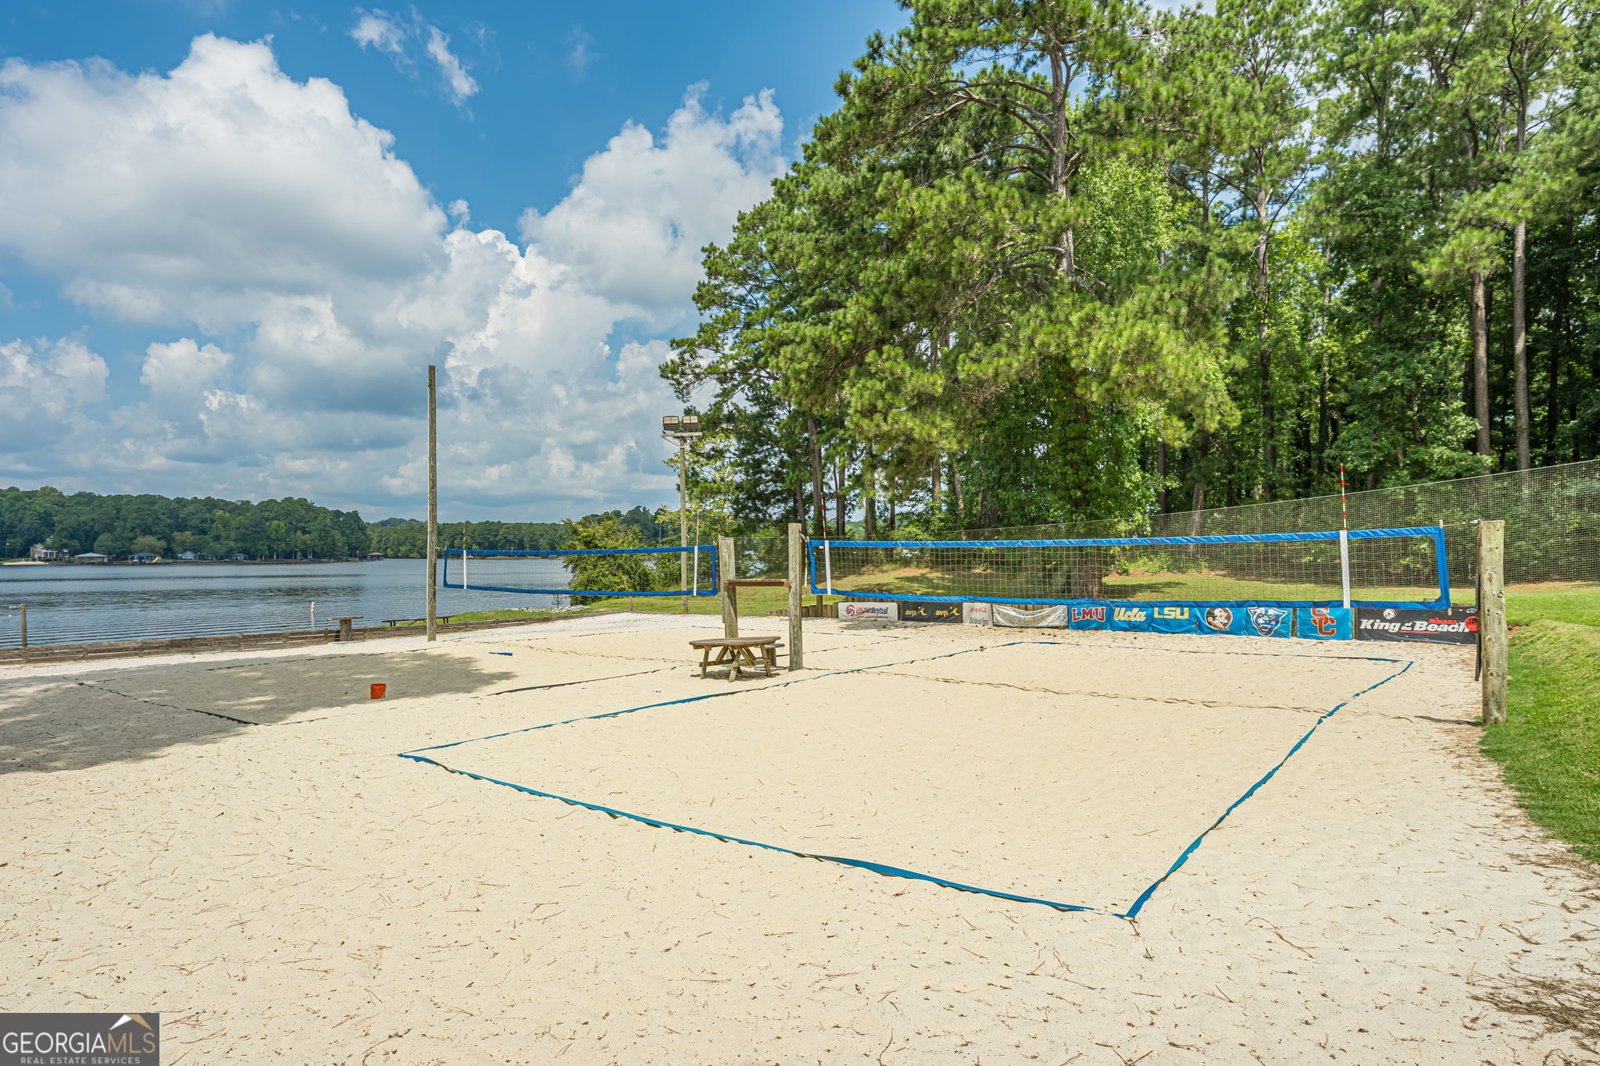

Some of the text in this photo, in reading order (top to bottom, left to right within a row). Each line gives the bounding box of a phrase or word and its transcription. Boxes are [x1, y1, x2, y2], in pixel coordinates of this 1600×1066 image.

[935, 609, 948, 617] avp
[1071, 607, 1106, 622] LMU
[1153, 606, 1190, 619] LSU
[1359, 618, 1401, 633] King
[1413, 620, 1470, 633] Beach
